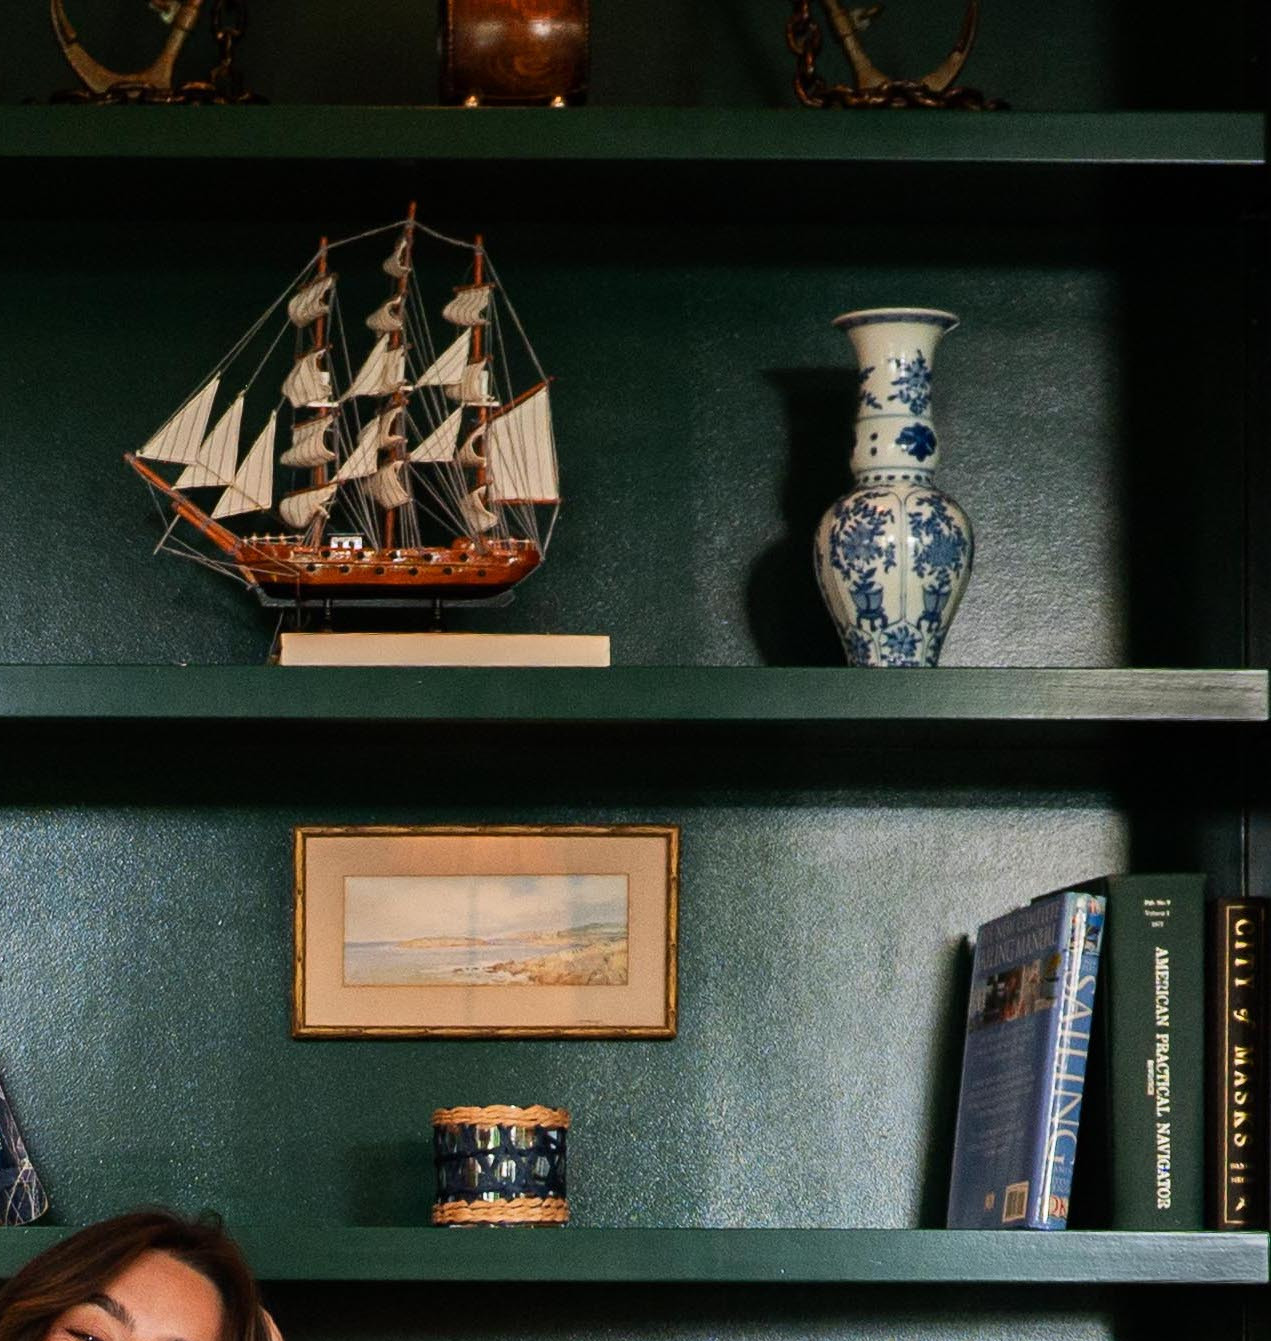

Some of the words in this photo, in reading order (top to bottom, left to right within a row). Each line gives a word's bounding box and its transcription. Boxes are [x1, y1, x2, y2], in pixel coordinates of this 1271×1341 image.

[1155, 946, 1170, 1027] AMERICAN
[1234, 918, 1254, 989] CITY
[1047, 971, 1097, 1166] SAILING
[1156, 1033, 1171, 1117] PRACTICAL
[1233, 1045, 1254, 1148] MASKS
[1156, 1121, 1173, 1210] NAVIGATOR
